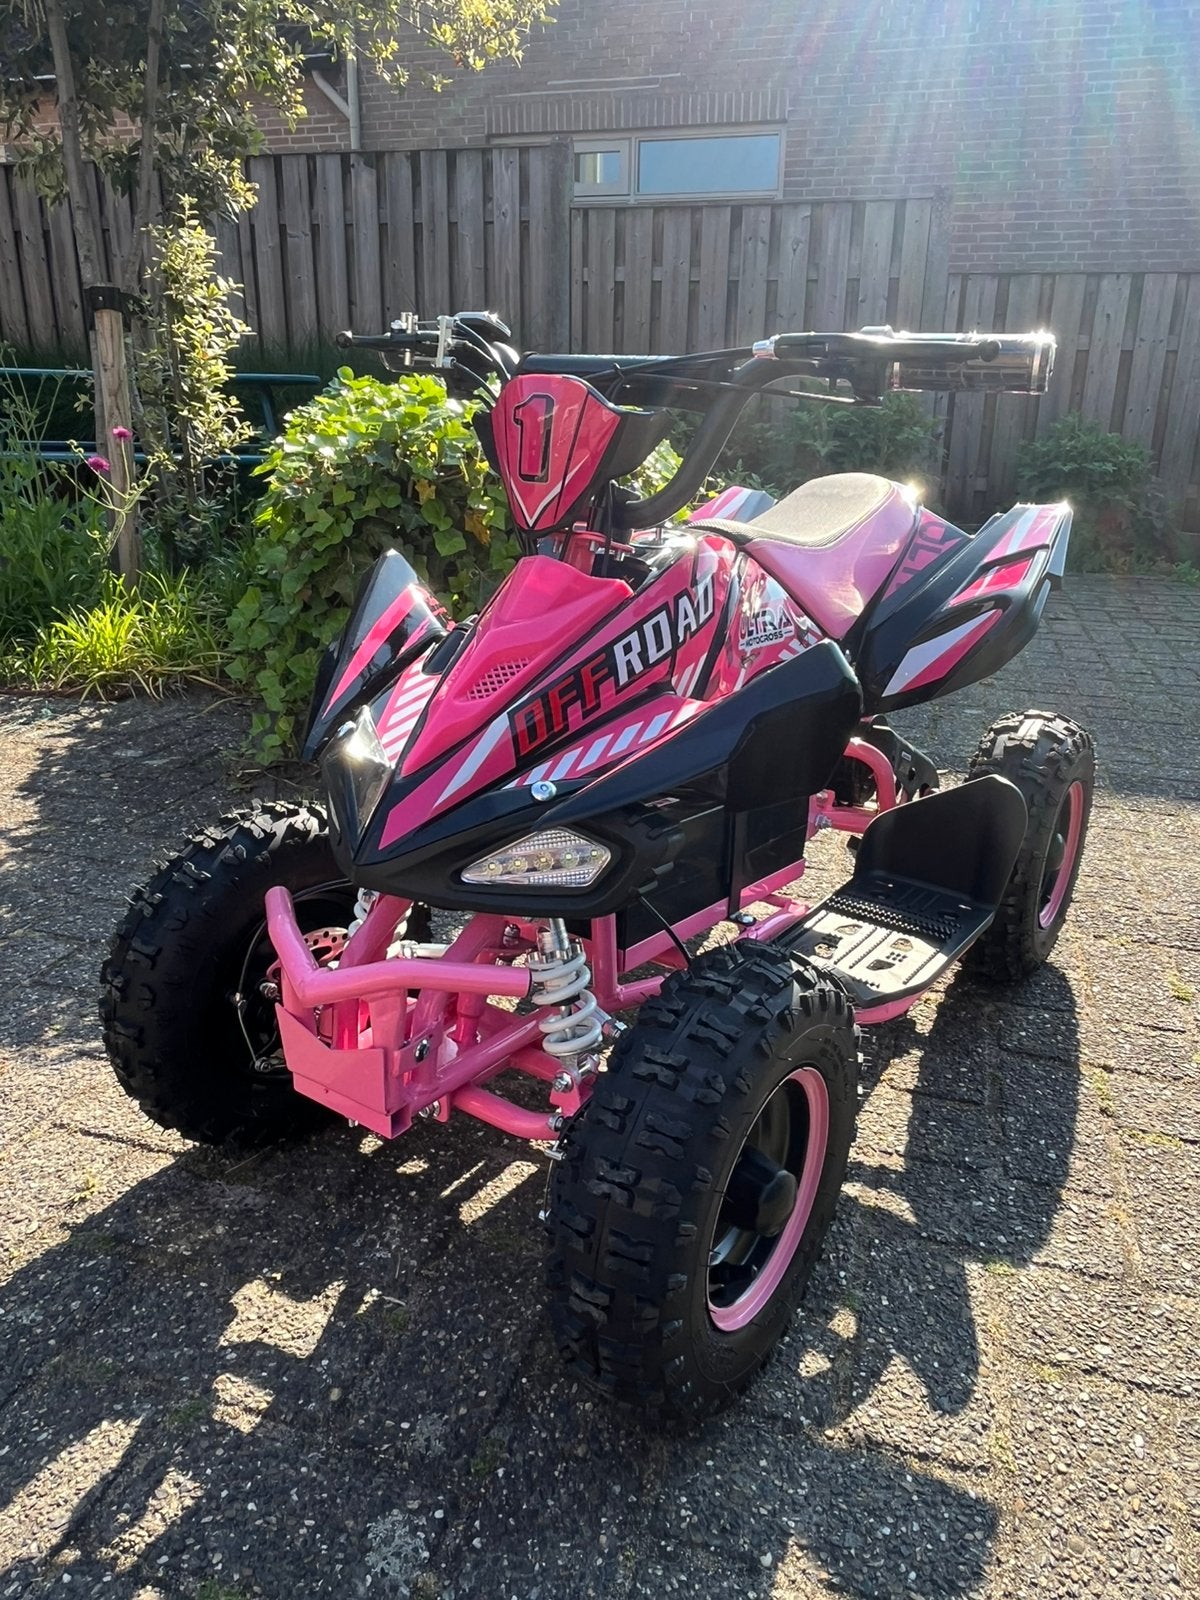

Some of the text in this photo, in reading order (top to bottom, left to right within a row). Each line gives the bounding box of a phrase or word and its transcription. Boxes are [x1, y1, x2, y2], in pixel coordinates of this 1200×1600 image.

[513, 392, 554, 483] 1
[740, 606, 793, 640] ULTRA
[745, 630, 784, 647] MOTOCROSS
